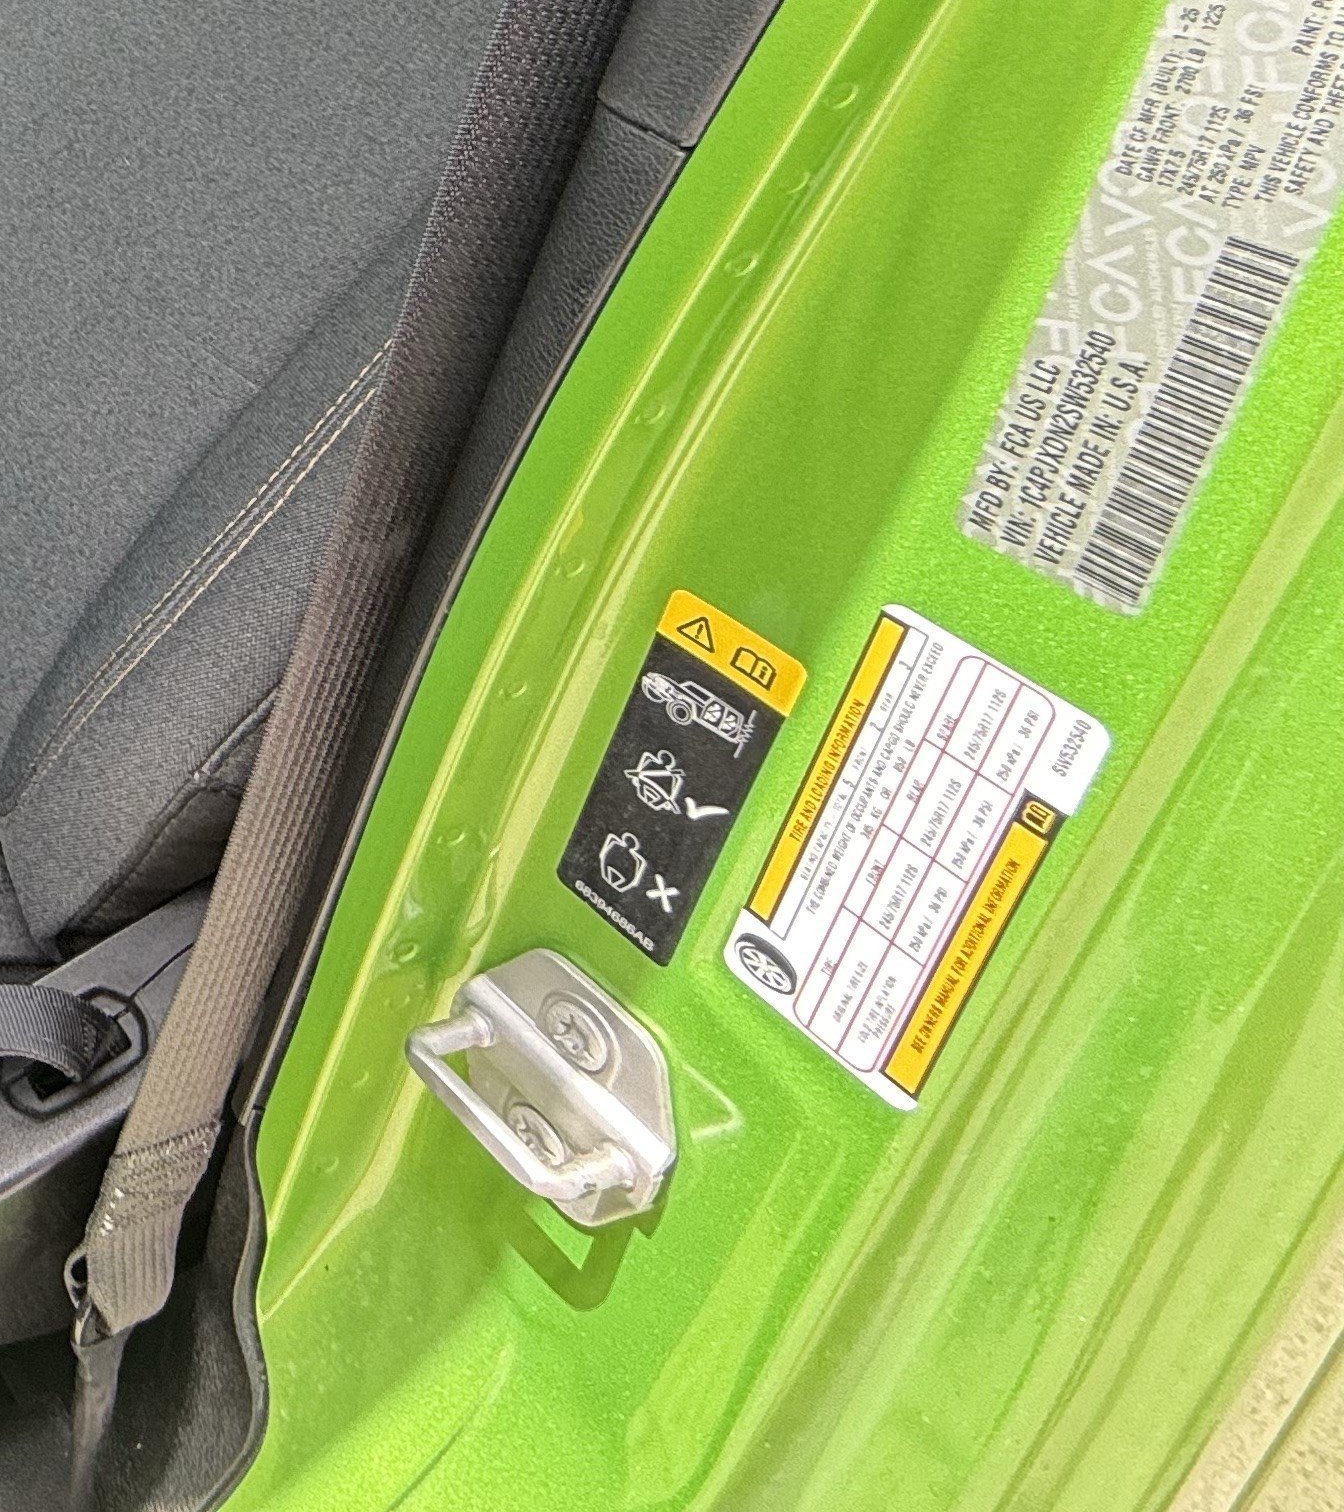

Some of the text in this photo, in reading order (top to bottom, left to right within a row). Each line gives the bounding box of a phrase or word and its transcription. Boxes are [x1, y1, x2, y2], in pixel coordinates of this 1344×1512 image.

[1114, 144, 1143, 175] DATE
[1136, 96, 1161, 124] MFR
[1253, 30, 1344, 203] THIS VEHICLE CONFORMS TO
[1135, 145, 1165, 182] GAWR
[1197, 186, 1220, 202] AT
[1233, 107, 1255, 123] 36
[1238, 145, 1266, 172] MPV
[1283, 149, 1321, 195] SAFETY
[1306, 118, 1334, 144] AND
[967, 357, 1062, 532] MFD BY: FCA US LLC
[999, 327, 1117, 549] VIN: 1C4PJXDN2SW532540
[1033, 350, 1150, 566] VEHICLE MADE IN: U.S.A.
[920, 641, 944, 675] EXCEED
[908, 673, 929, 702] NEVER
[892, 699, 916, 734] SHOULD
[789, 697, 865, 842] TIRE AND LOADING INFORMATION
[871, 759, 887, 777] AND
[1050, 717, 1092, 778] SW532540
[850, 776, 878, 822] OCCUPANTS
[830, 831, 852, 861] WEIGHT
[844, 821, 857, 833] OF
[805, 897, 820, 914] THE
[933, 973, 960, 1008] MANUAL
[949, 955, 969, 977] FOR
[959, 912, 991, 960] ADDITIONAL
[982, 857, 1020, 915] INFORMATION
